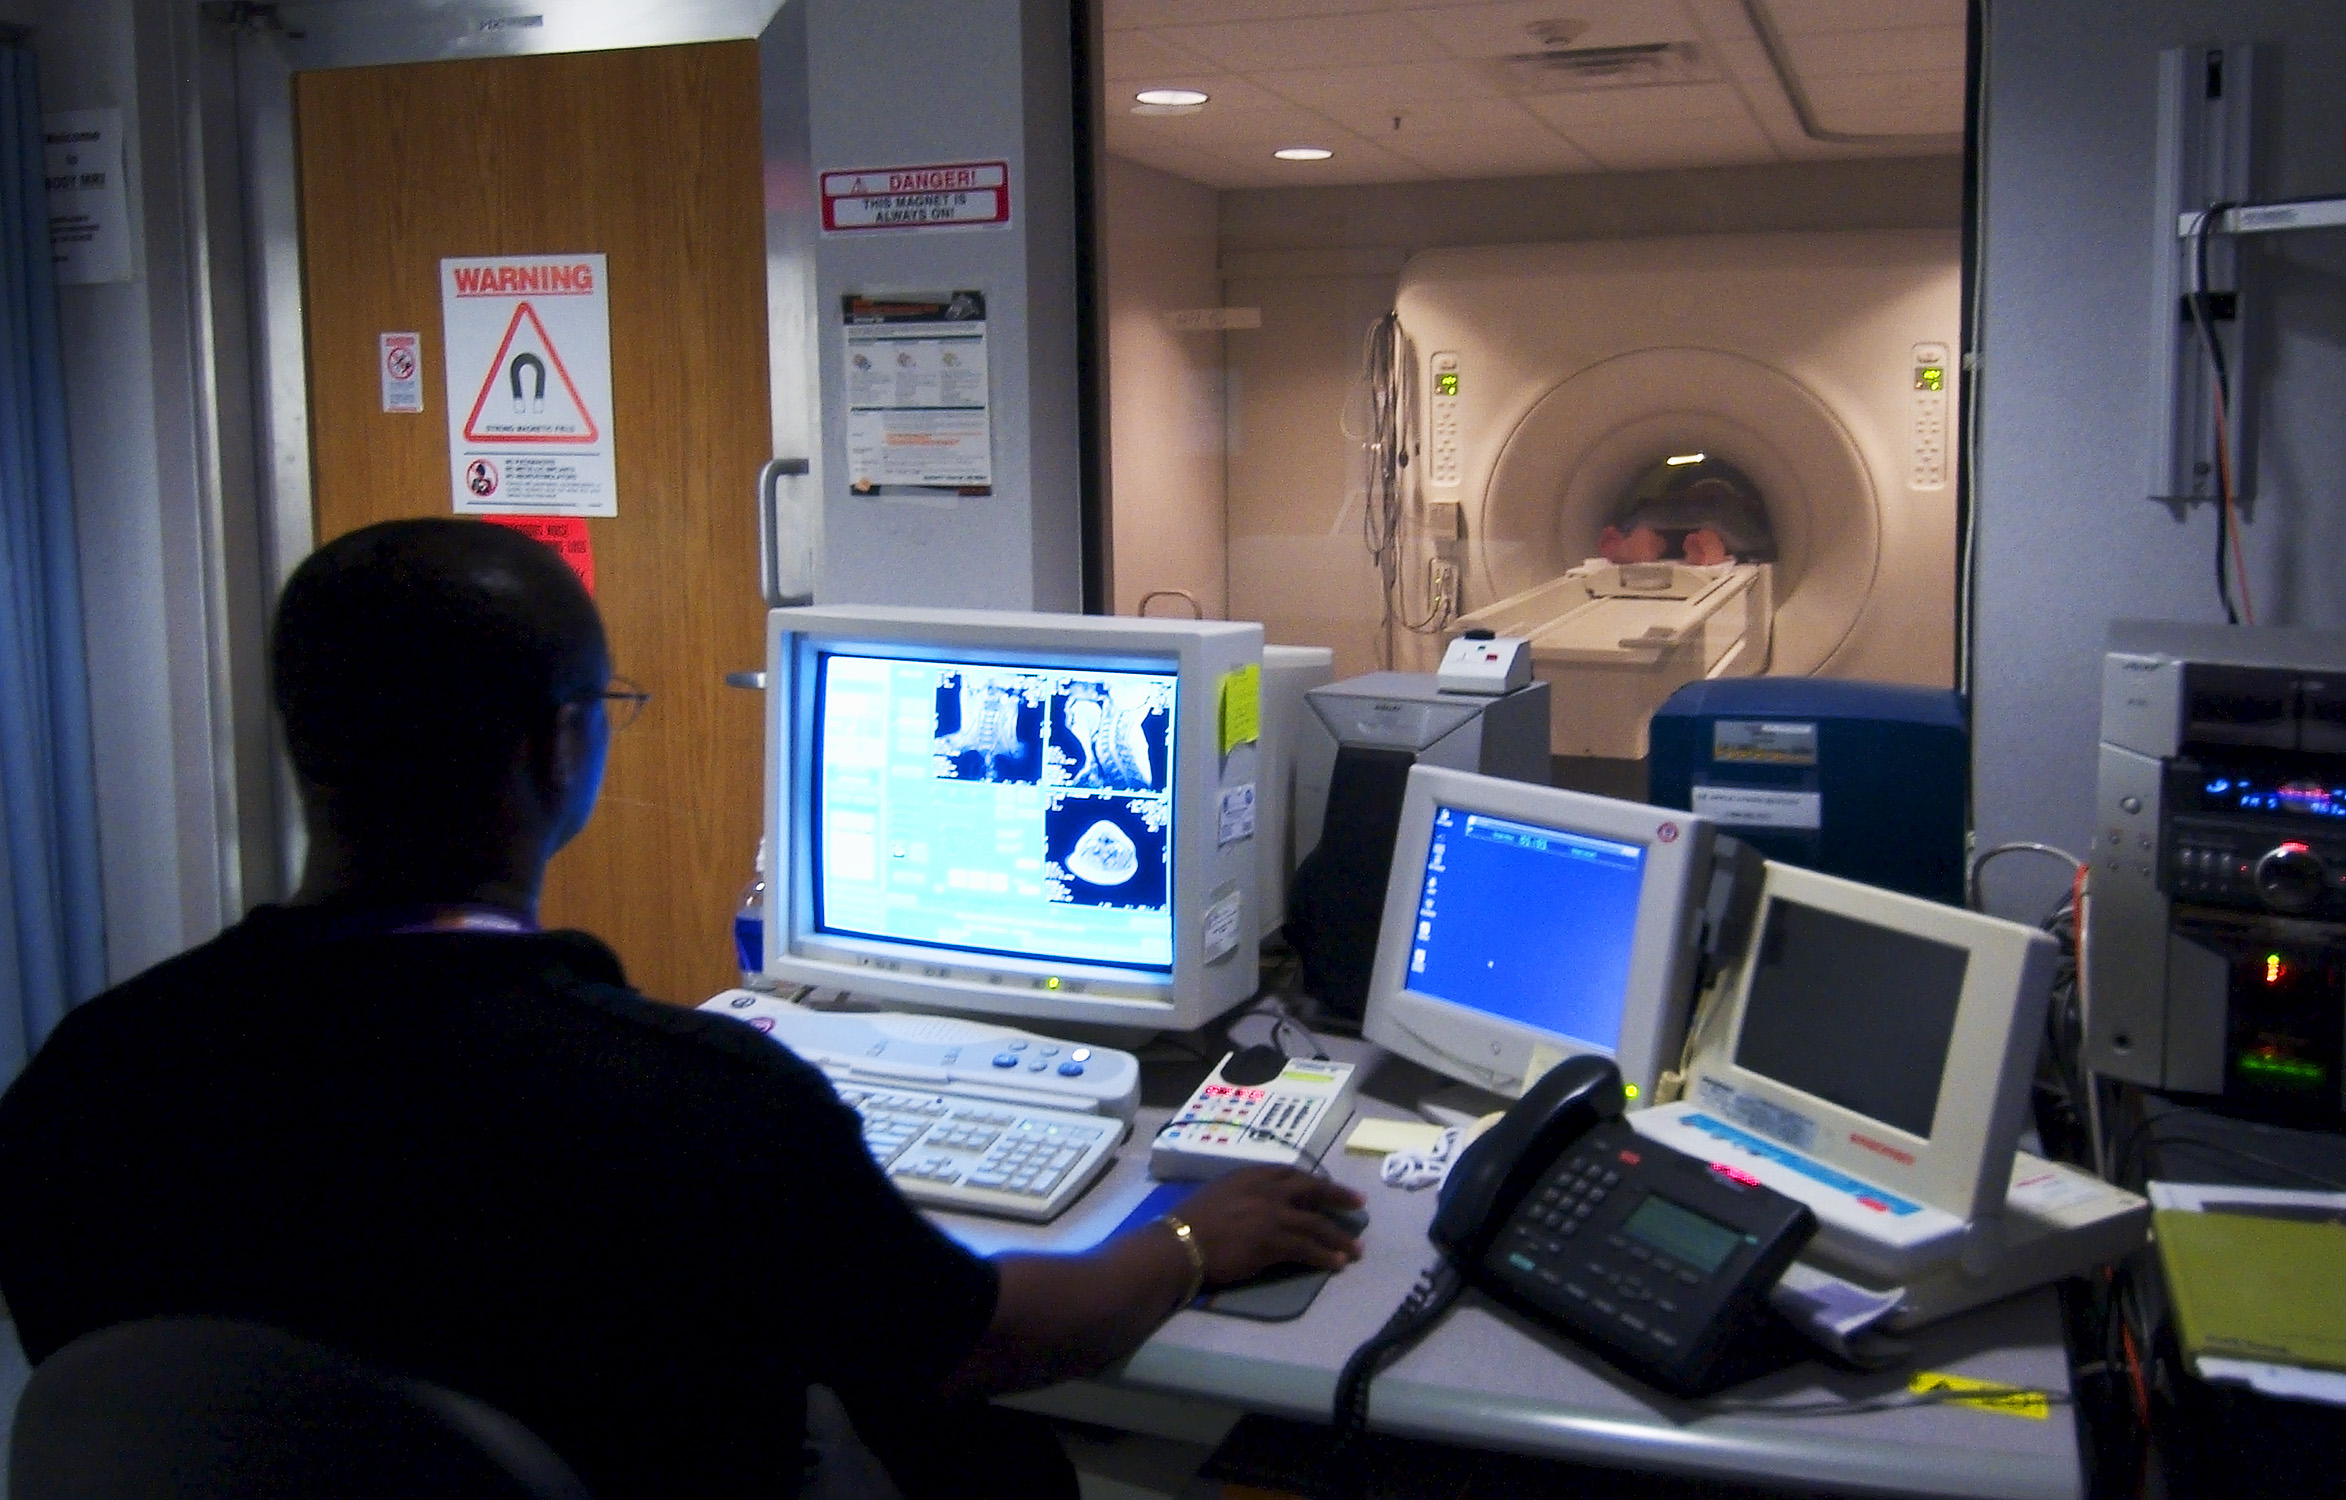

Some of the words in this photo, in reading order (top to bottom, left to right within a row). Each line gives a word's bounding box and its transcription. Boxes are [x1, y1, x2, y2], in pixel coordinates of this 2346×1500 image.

[889, 171, 975, 192] DANGER!
[863, 197, 891, 210] THIS
[896, 195, 948, 208] MAGNET
[954, 193, 967, 206] IS
[875, 208, 927, 223] ALWAYS
[931, 207, 955, 219] ON!
[454, 263, 594, 292] WARNING
